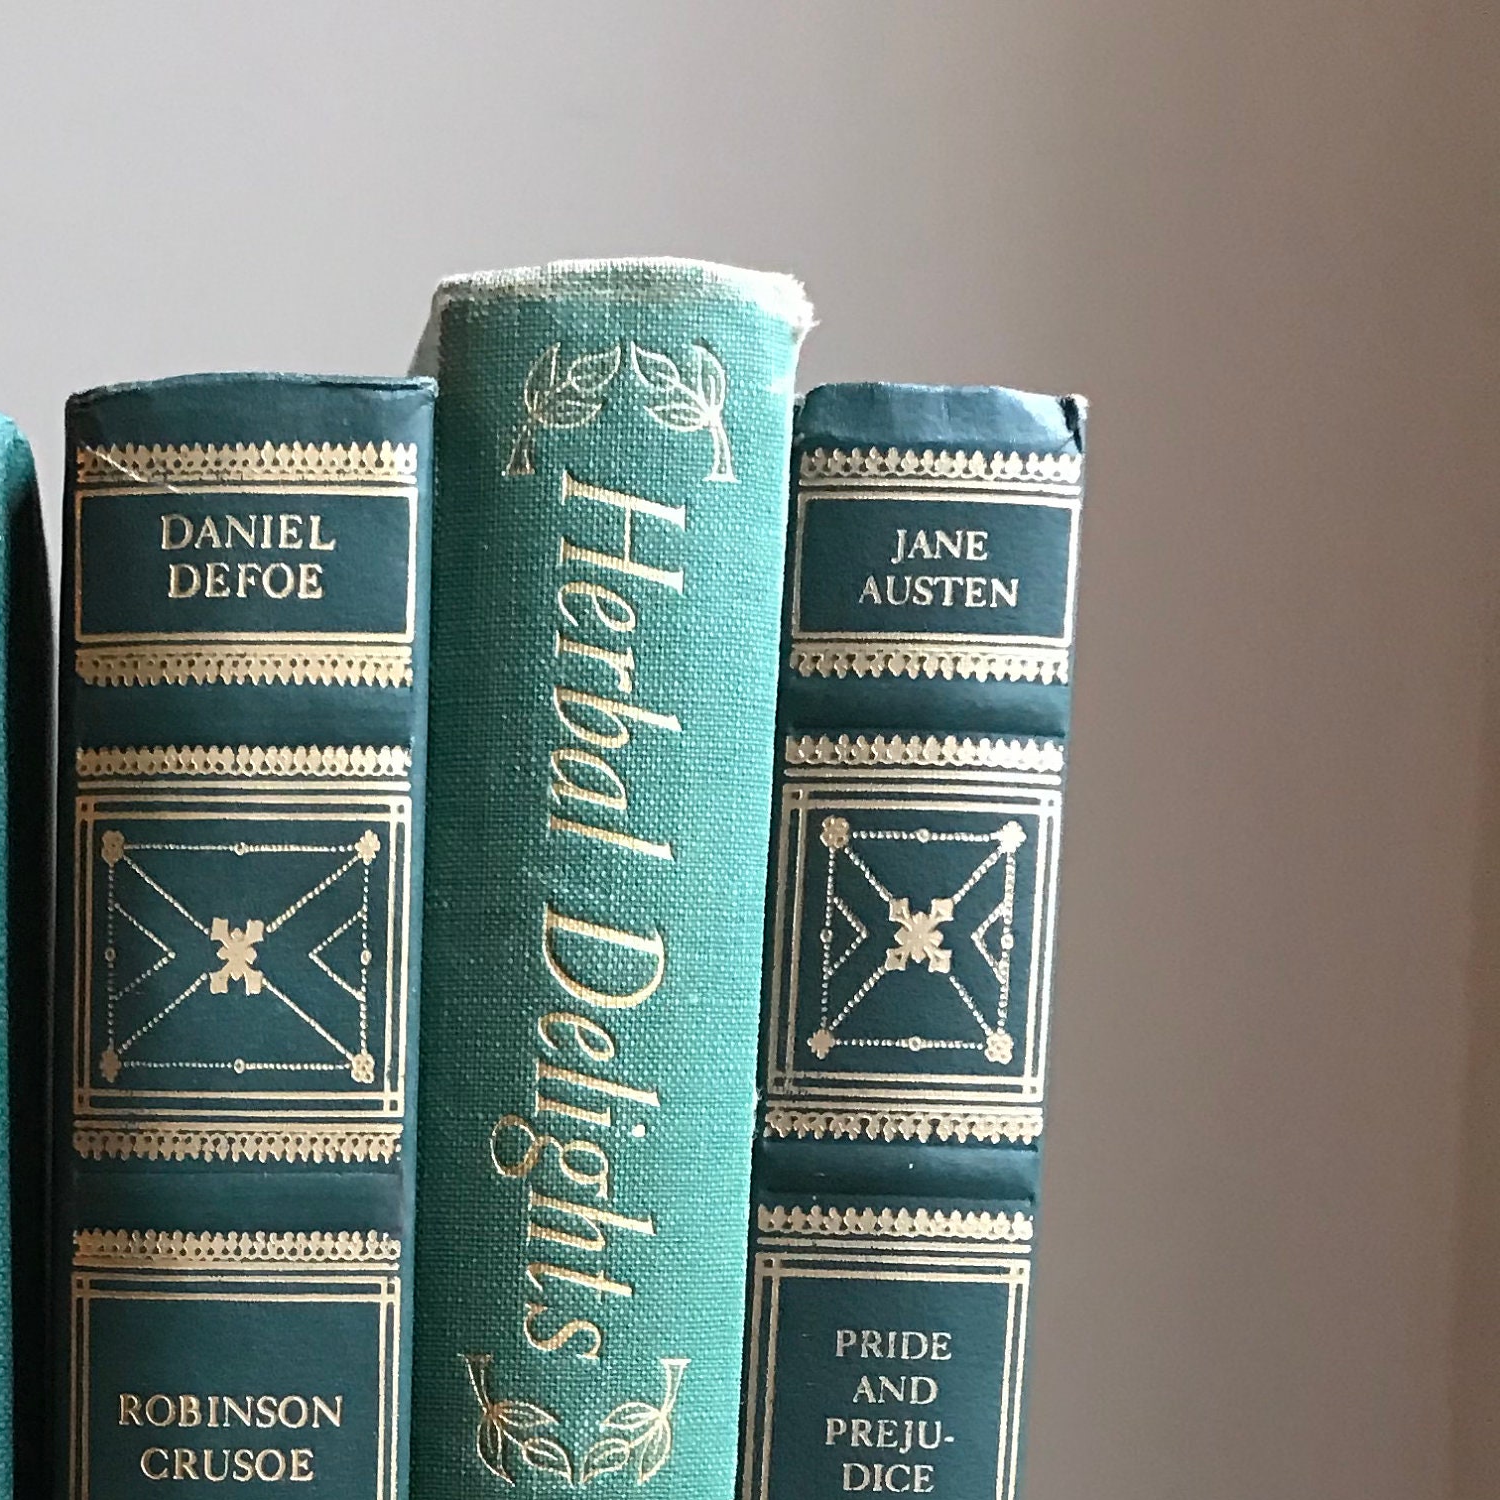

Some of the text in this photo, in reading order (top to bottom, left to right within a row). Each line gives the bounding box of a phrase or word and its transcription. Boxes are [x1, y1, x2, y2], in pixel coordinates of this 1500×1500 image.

[160, 513, 337, 551] DANIEL
[890, 528, 989, 565] JANE
[167, 561, 327, 600] DEFOE
[858, 574, 1020, 608] AUSTEN
[489, 469, 686, 1361] Herbal Delights
[835, 1329, 953, 1361] PRIDE
[852, 1375, 940, 1405] AND
[118, 1393, 344, 1429] ROBINSON
[824, 1417, 956, 1455] PREJU-
[139, 1447, 316, 1482] CRUSOE
[842, 1462, 935, 1493] DICE
